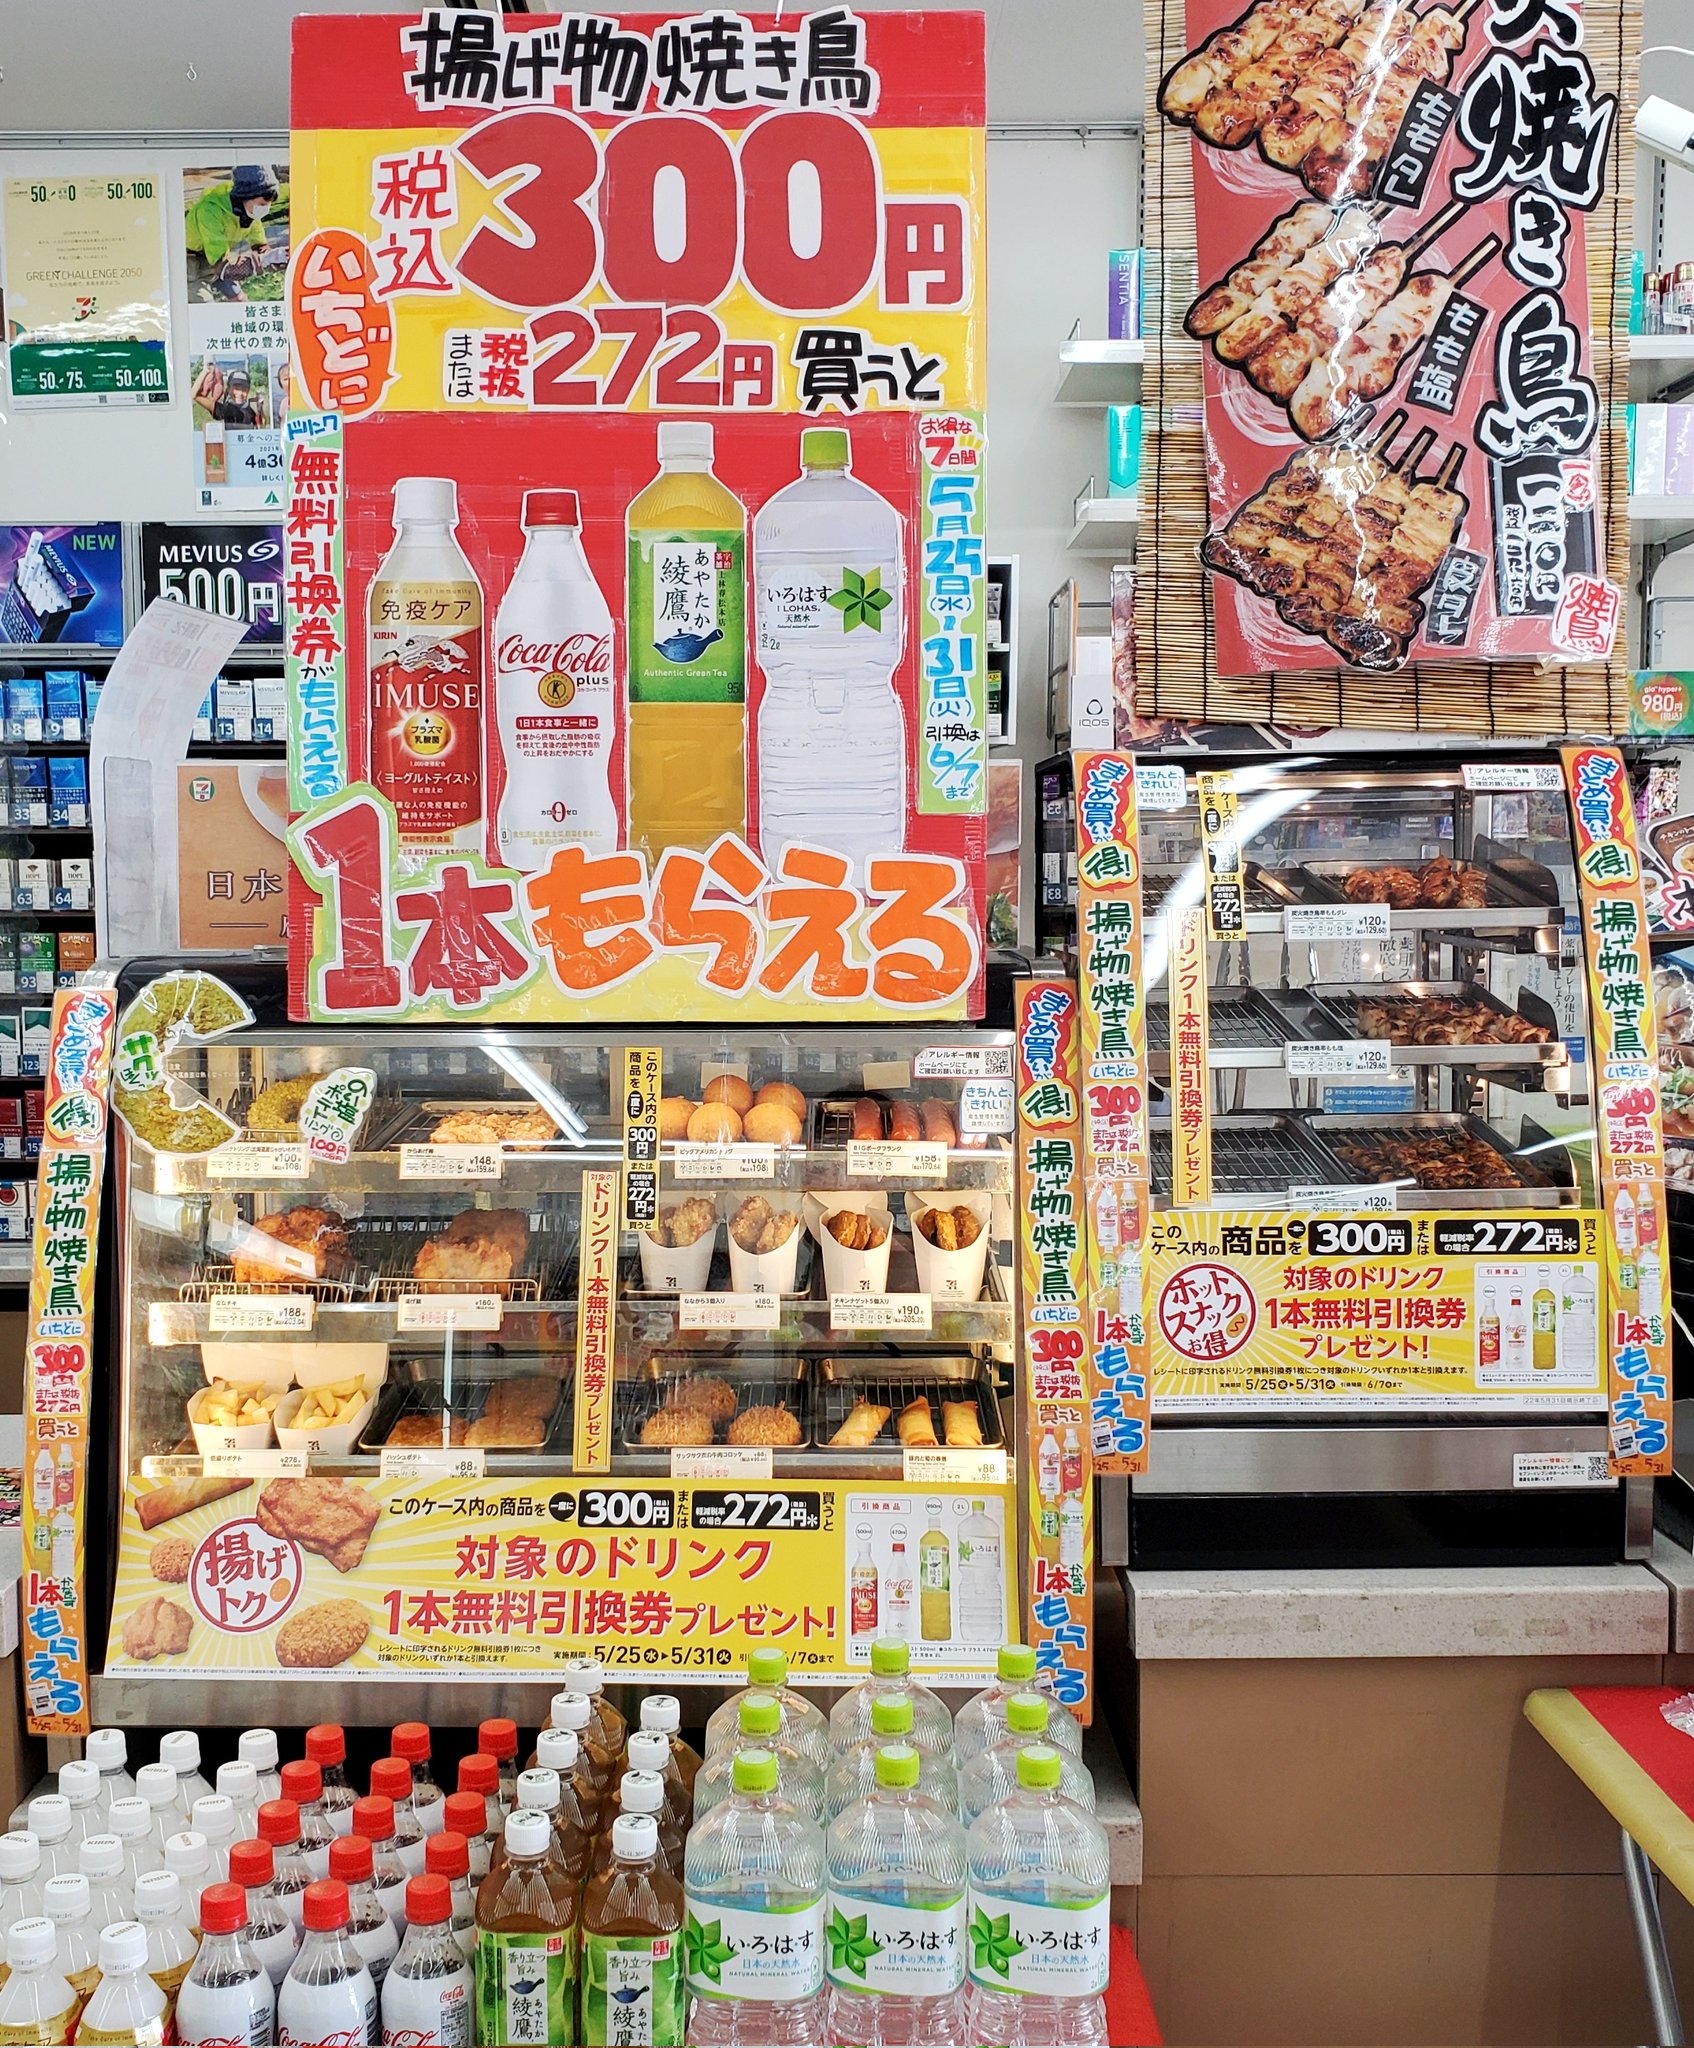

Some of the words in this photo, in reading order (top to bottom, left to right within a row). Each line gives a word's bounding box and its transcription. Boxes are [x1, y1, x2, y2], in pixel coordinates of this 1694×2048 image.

[409, 12, 871, 111] 揚げ物焼き鳥
[1388, 92, 1454, 204] ももタレ
[377, 149, 452, 295] 税込
[457, 111, 966, 309] 300円
[26, 270, 61, 281] GREEN
[61, 268, 119, 281] CHALLENGE
[120, 267, 143, 278] 2050
[1117, 253, 1131, 308] SENTIA
[300, 243, 391, 411] いちどに
[449, 333, 474, 399] または
[480, 331, 528, 400] 税抜
[531, 307, 776, 407] 272円
[1413, 303, 1480, 412] もも塩
[796, 329, 945, 414] 買うと
[287, 413, 339, 441] ドリンク
[921, 416, 972, 436] お得な
[925, 435, 978, 467] 7日間
[72, 534, 117, 551] NEW
[159, 544, 243, 564] MEVIUS
[158, 566, 282, 624] 500円
[659, 554, 693, 622] 綾鷹
[693, 547, 711, 630] あやたか
[381, 599, 472, 621] 免疫ケア
[785, 613, 811, 623] 天然水
[373, 631, 398, 640] KIRIN
[499, 633, 610, 674] Coca-Cola
[576, 674, 609, 687] plus
[643, 668, 684, 678] Authentic
[686, 669, 711, 678] Green
[712, 669, 728, 678] Tea
[1641, 694, 1683, 713] 980円
[12, 723, 22, 736] 8
[50, 723, 62, 736] 9
[218, 722, 235, 735] 13
[256, 722, 274, 736] 14
[410, 724, 443, 735] プラズマ
[926, 725, 981, 742] 引換は
[414, 735, 441, 745] 乳酸菌
[945, 784, 974, 799] まで
[1084, 759, 1130, 844] まとめ買いが
[14, 808, 30, 822] 33
[52, 809, 69, 822] 34
[1085, 846, 1131, 879] 得!
[1585, 844, 1632, 879] 得!
[17, 892, 33, 906] 63
[55, 892, 72, 905] 64
[306, 800, 975, 1011] 1本もらえる
[1211, 898, 1241, 912] 272
[1358, 916, 1382, 926] ¥120
[21, 934, 51, 945] CAMEL
[61, 934, 91, 944] CAMEL
[1215, 931, 1240, 940] 買うと
[20, 976, 37, 988] 93
[59, 975, 76, 988] 94
[1087, 901, 1136, 1059] 揚げ物・焼き鳥
[1591, 901, 1647, 1061] 揚げ物・焼き鳥
[928, 1051, 980, 1059] アレルギー情報
[1358, 1051, 1382, 1061] ¥120
[23, 1060, 39, 1071] 123
[629, 1051, 642, 1088] 商品を
[1092, 1065, 1136, 1078] いちどに
[1608, 1066, 1650, 1080] いちどに
[646, 1051, 658, 1126] このケース内の
[629, 1128, 656, 1142] 300
[636, 1141, 649, 1153] 円
[1610, 1140, 1656, 1154] 272円
[469, 1155, 492, 1165] ¥148
[630, 1162, 653, 1171] または
[1613, 1158, 1656, 1178] 買うと
[628, 1187, 655, 1201] 272
[1364, 1196, 1388, 1207] ¥120
[628, 1221, 652, 1230] 買うと
[1028, 1139, 1078, 1304] 揚げ物・焼き鳥
[43, 1153, 91, 1317] 揚げ物・焼き鳥
[1151, 1225, 1182, 1239] この
[1151, 1241, 1219, 1256] ケース内の
[1220, 1226, 1286, 1257] 商品
[1416, 1219, 1430, 1256] または
[1583, 1218, 1597, 1256] 買うと
[1283, 1265, 1444, 1292] 対象のドリンク
[1169, 1270, 1230, 1305] ホット
[279, 1306, 302, 1317] ¥188
[897, 1305, 921, 1316] ¥190
[1034, 1308, 1078, 1322] いちどに
[1165, 1292, 1243, 1340] スナック
[1264, 1297, 1467, 1331] 1本無料引換券
[40, 1321, 82, 1336] いちどに
[1033, 1329, 1084, 1362] 300
[1187, 1329, 1229, 1357] お得
[1299, 1334, 1429, 1360] プレゼント!
[1034, 1375, 1059, 1386] または
[1035, 1385, 1083, 1399] 272円
[1037, 1404, 1080, 1425] 買うと
[38, 1417, 78, 1439] 買うと
[388, 1496, 547, 1518] このケース内の商品を
[677, 1490, 690, 1529] または
[694, 1505, 726, 1516] 軽減税率
[822, 1491, 835, 1532] 買うと
[861, 1502, 901, 1511] 引換商品
[699, 1516, 722, 1526] の場合
[204, 1530, 290, 1588] 揚げ
[454, 1533, 772, 1582] 対象のドリンク
[216, 1586, 269, 1625] トク
[27, 1607, 84, 1715] もらえる
[4, 1835, 31, 1844] KIRIN
[506, 1952, 547, 1965] 香り立つ
[607, 1955, 653, 1970] 香り立つ
[742, 1955, 801, 1970] 日本の天然水
[887, 1953, 947, 1966] 日本の天然水
[1030, 1953, 1090, 1966] 日本の天然水
[516, 1964, 536, 1976] 旨み
[618, 1969, 641, 1983] 旨み
[439, 1985, 465, 2002] Coca-Cola
[511, 1998, 535, 2040] 綾鷹
[533, 1999, 546, 2039] あやたか
